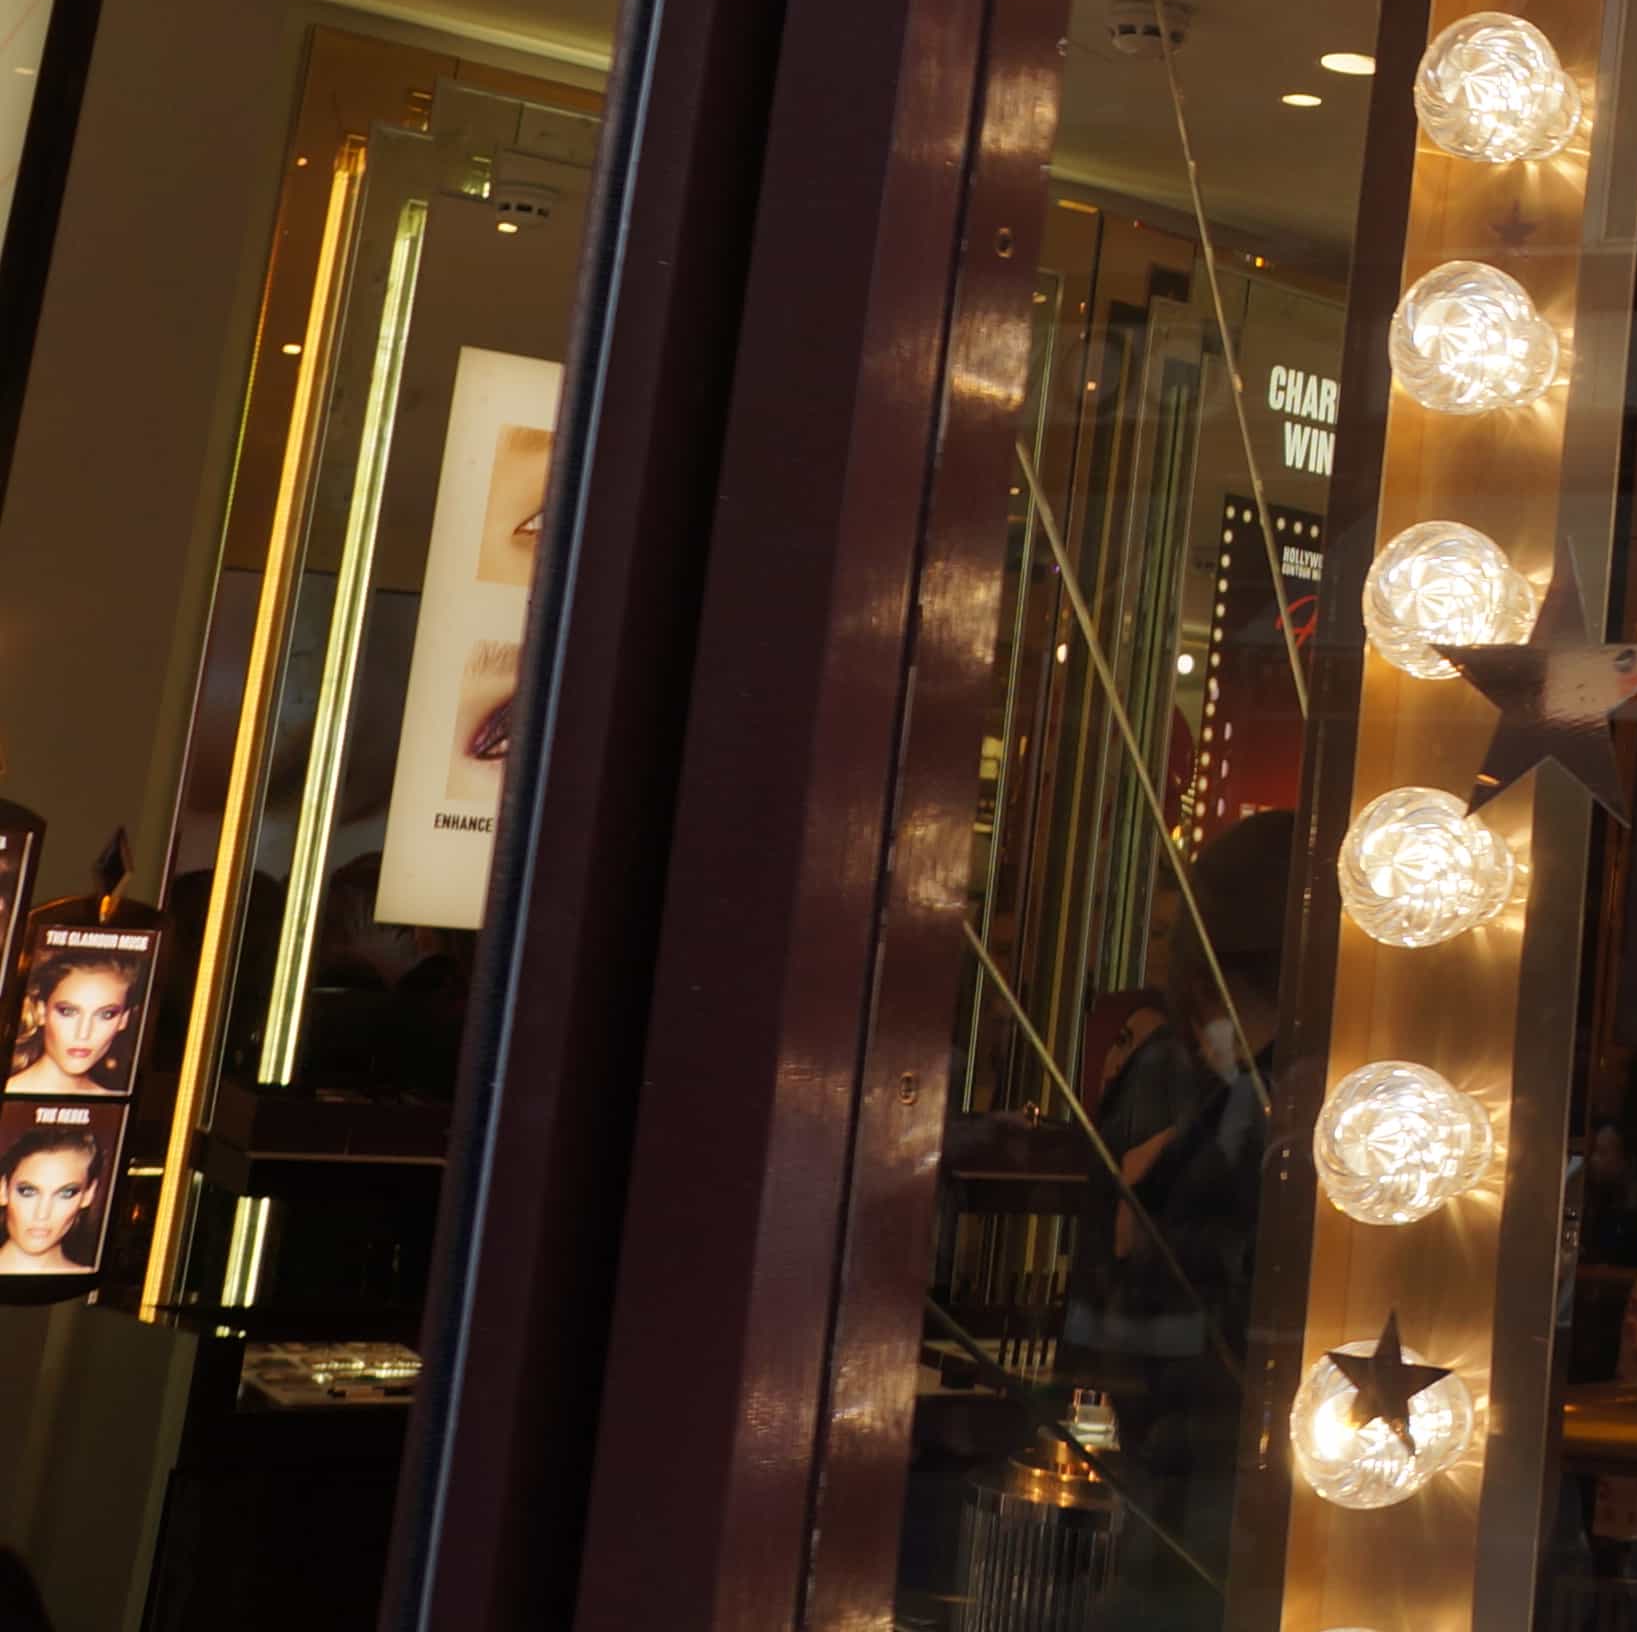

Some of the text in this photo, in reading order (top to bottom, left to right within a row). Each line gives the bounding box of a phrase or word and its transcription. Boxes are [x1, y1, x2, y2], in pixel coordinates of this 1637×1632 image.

[1269, 365, 1339, 425] CHAR
[1284, 422, 1336, 477] WIN
[433, 812, 494, 833] ENHANCE
[46, 928, 67, 947] THE
[36, 1108, 60, 1125] THE
